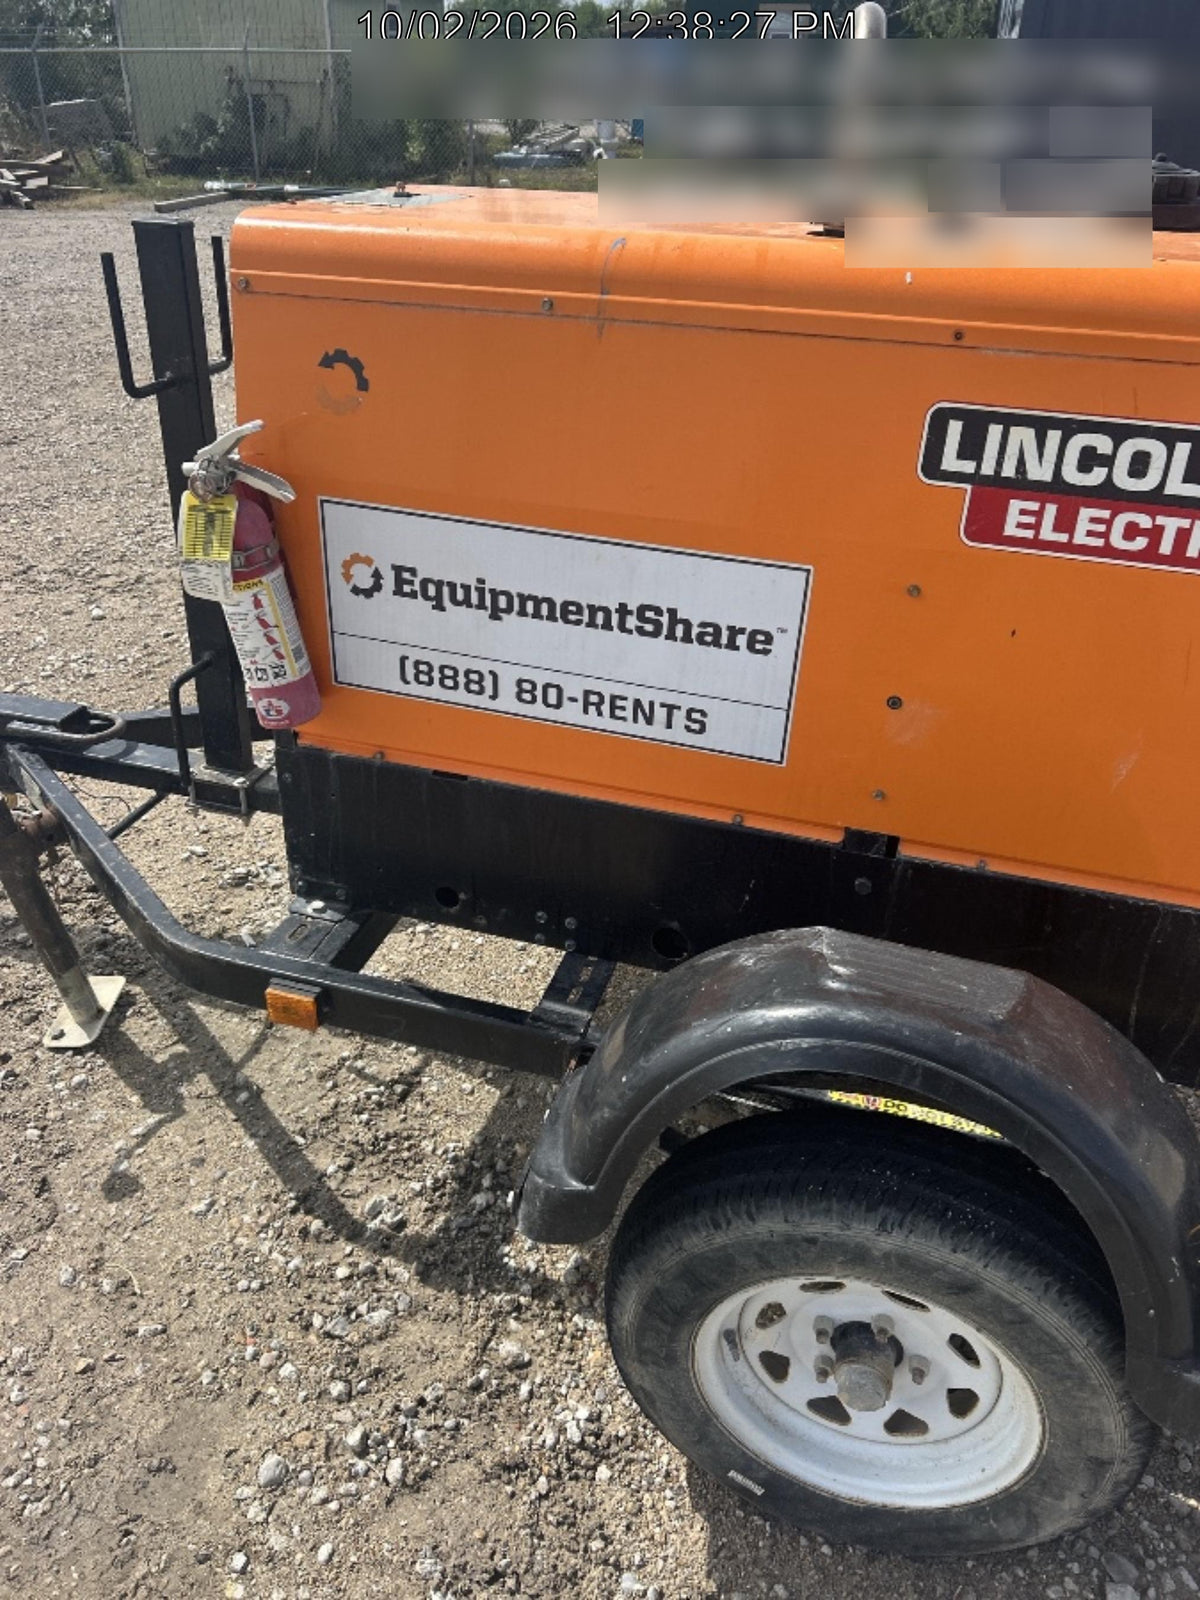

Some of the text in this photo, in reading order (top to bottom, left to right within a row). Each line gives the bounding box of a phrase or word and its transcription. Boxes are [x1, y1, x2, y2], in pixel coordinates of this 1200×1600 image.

[391, 563, 775, 657] EquipmentShare
[398, 655, 709, 737] (888) 80-RENTS
